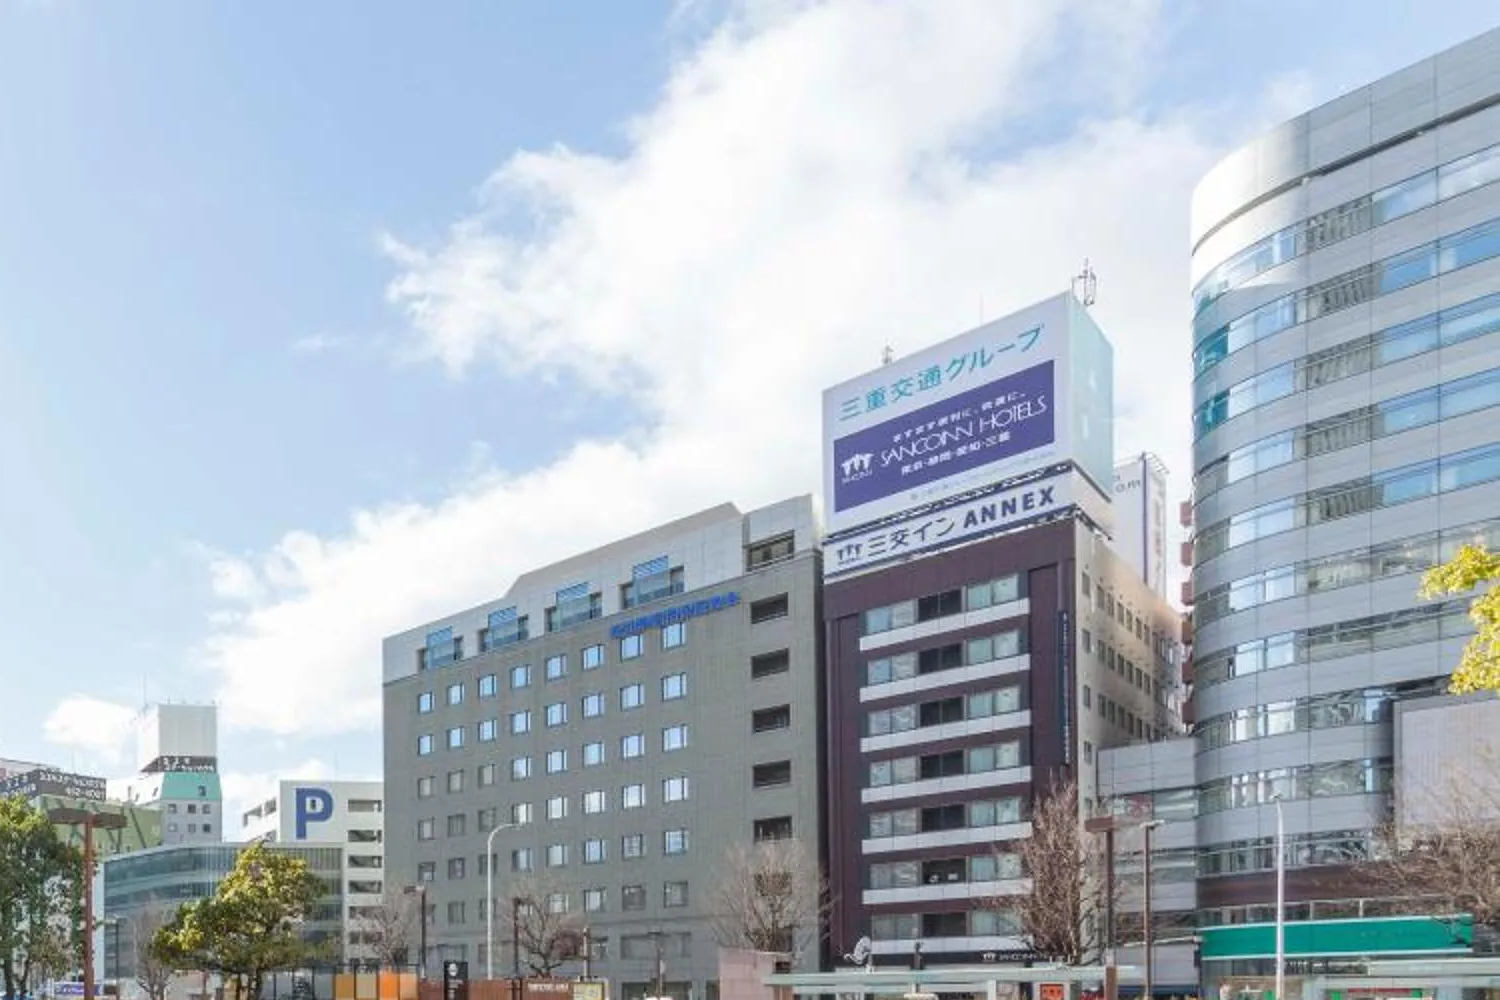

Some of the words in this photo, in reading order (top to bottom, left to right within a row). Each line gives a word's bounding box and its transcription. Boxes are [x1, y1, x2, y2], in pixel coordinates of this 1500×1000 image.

[839, 323, 1045, 421] 三重交通グループ
[979, 394, 1048, 431] HOTELS
[867, 516, 955, 557] 三交イン
[963, 486, 1055, 529] ANNEX
[295, 787, 334, 840] P
